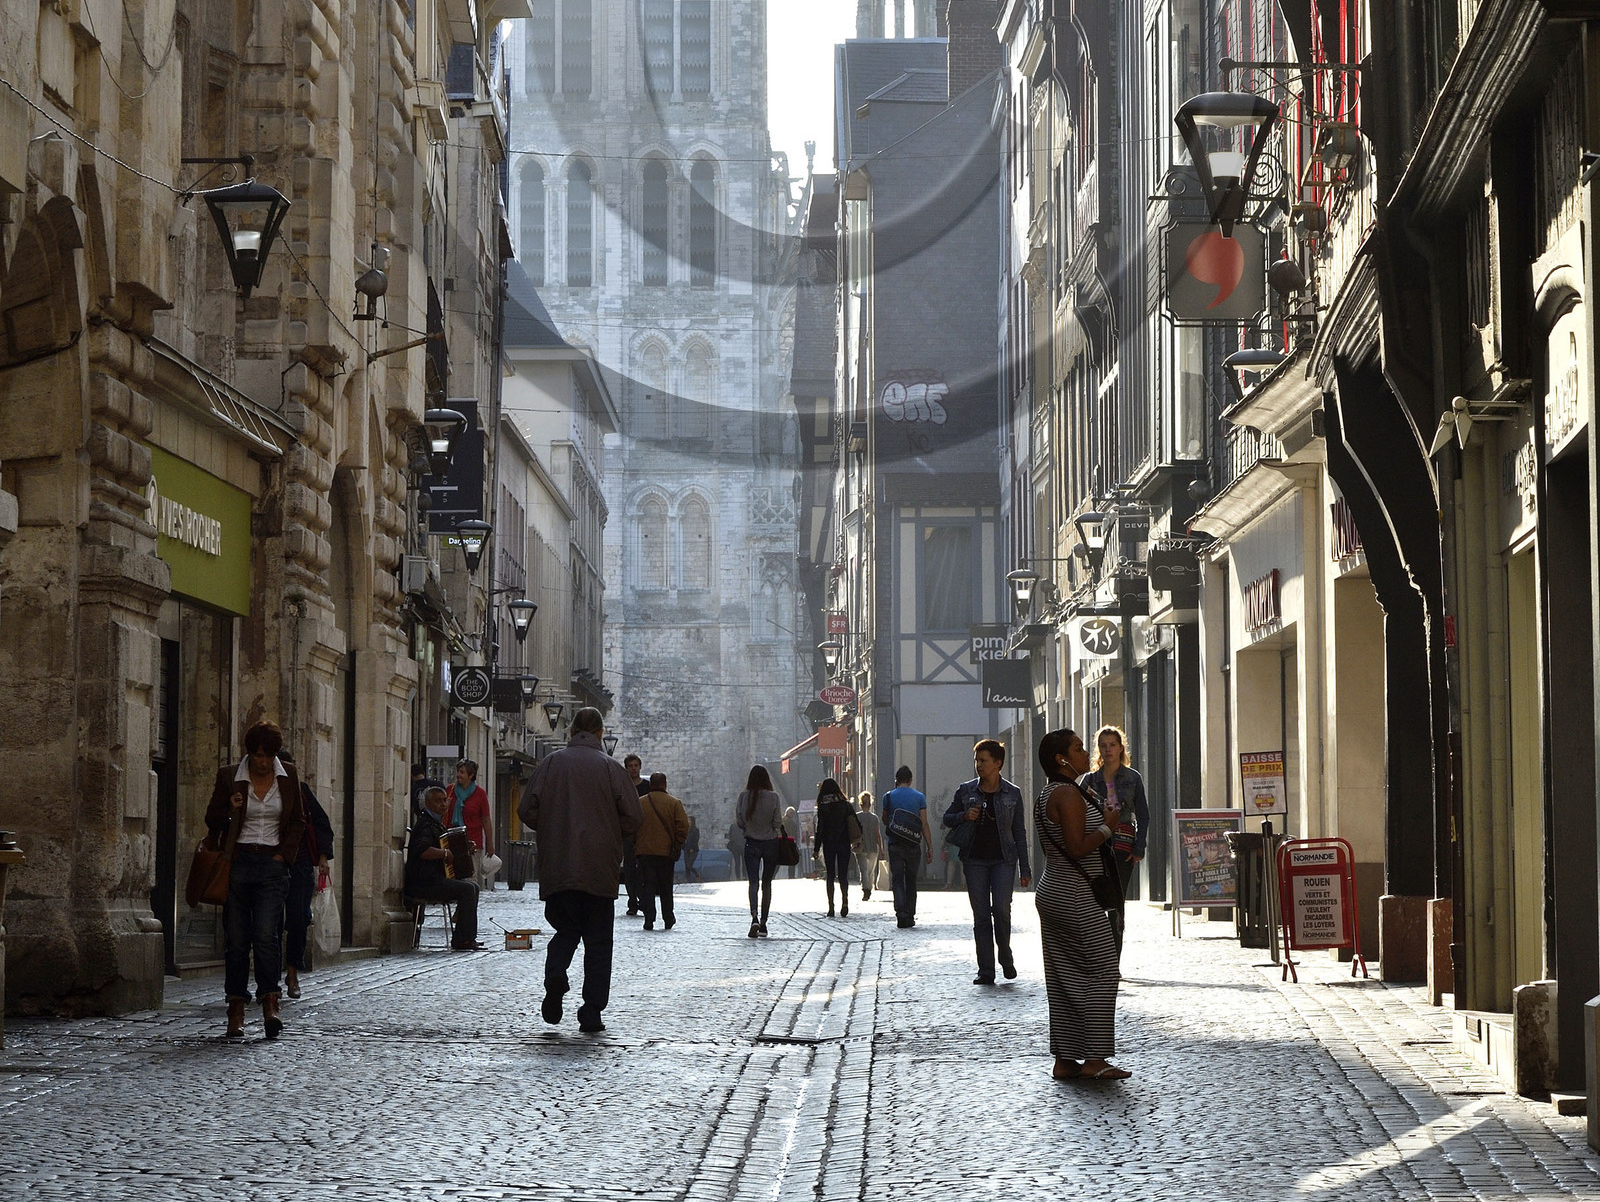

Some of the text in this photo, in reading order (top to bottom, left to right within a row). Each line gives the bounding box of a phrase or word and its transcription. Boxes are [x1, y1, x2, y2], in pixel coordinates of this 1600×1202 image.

[158, 495, 221, 556] YVES ROCHER
[831, 620, 846, 628] SFR
[972, 637, 1005, 652] pim
[825, 688, 853, 698] Brioche
[1241, 753, 1282, 764] BAISSE
[1259, 763, 1283, 772] PRIX
[893, 823, 913, 836] adidas
[1293, 852, 1335, 862] NORMANDIE
[1304, 877, 1331, 887] ROUEN
[1298, 898, 1338, 906] COMMUNISTES
